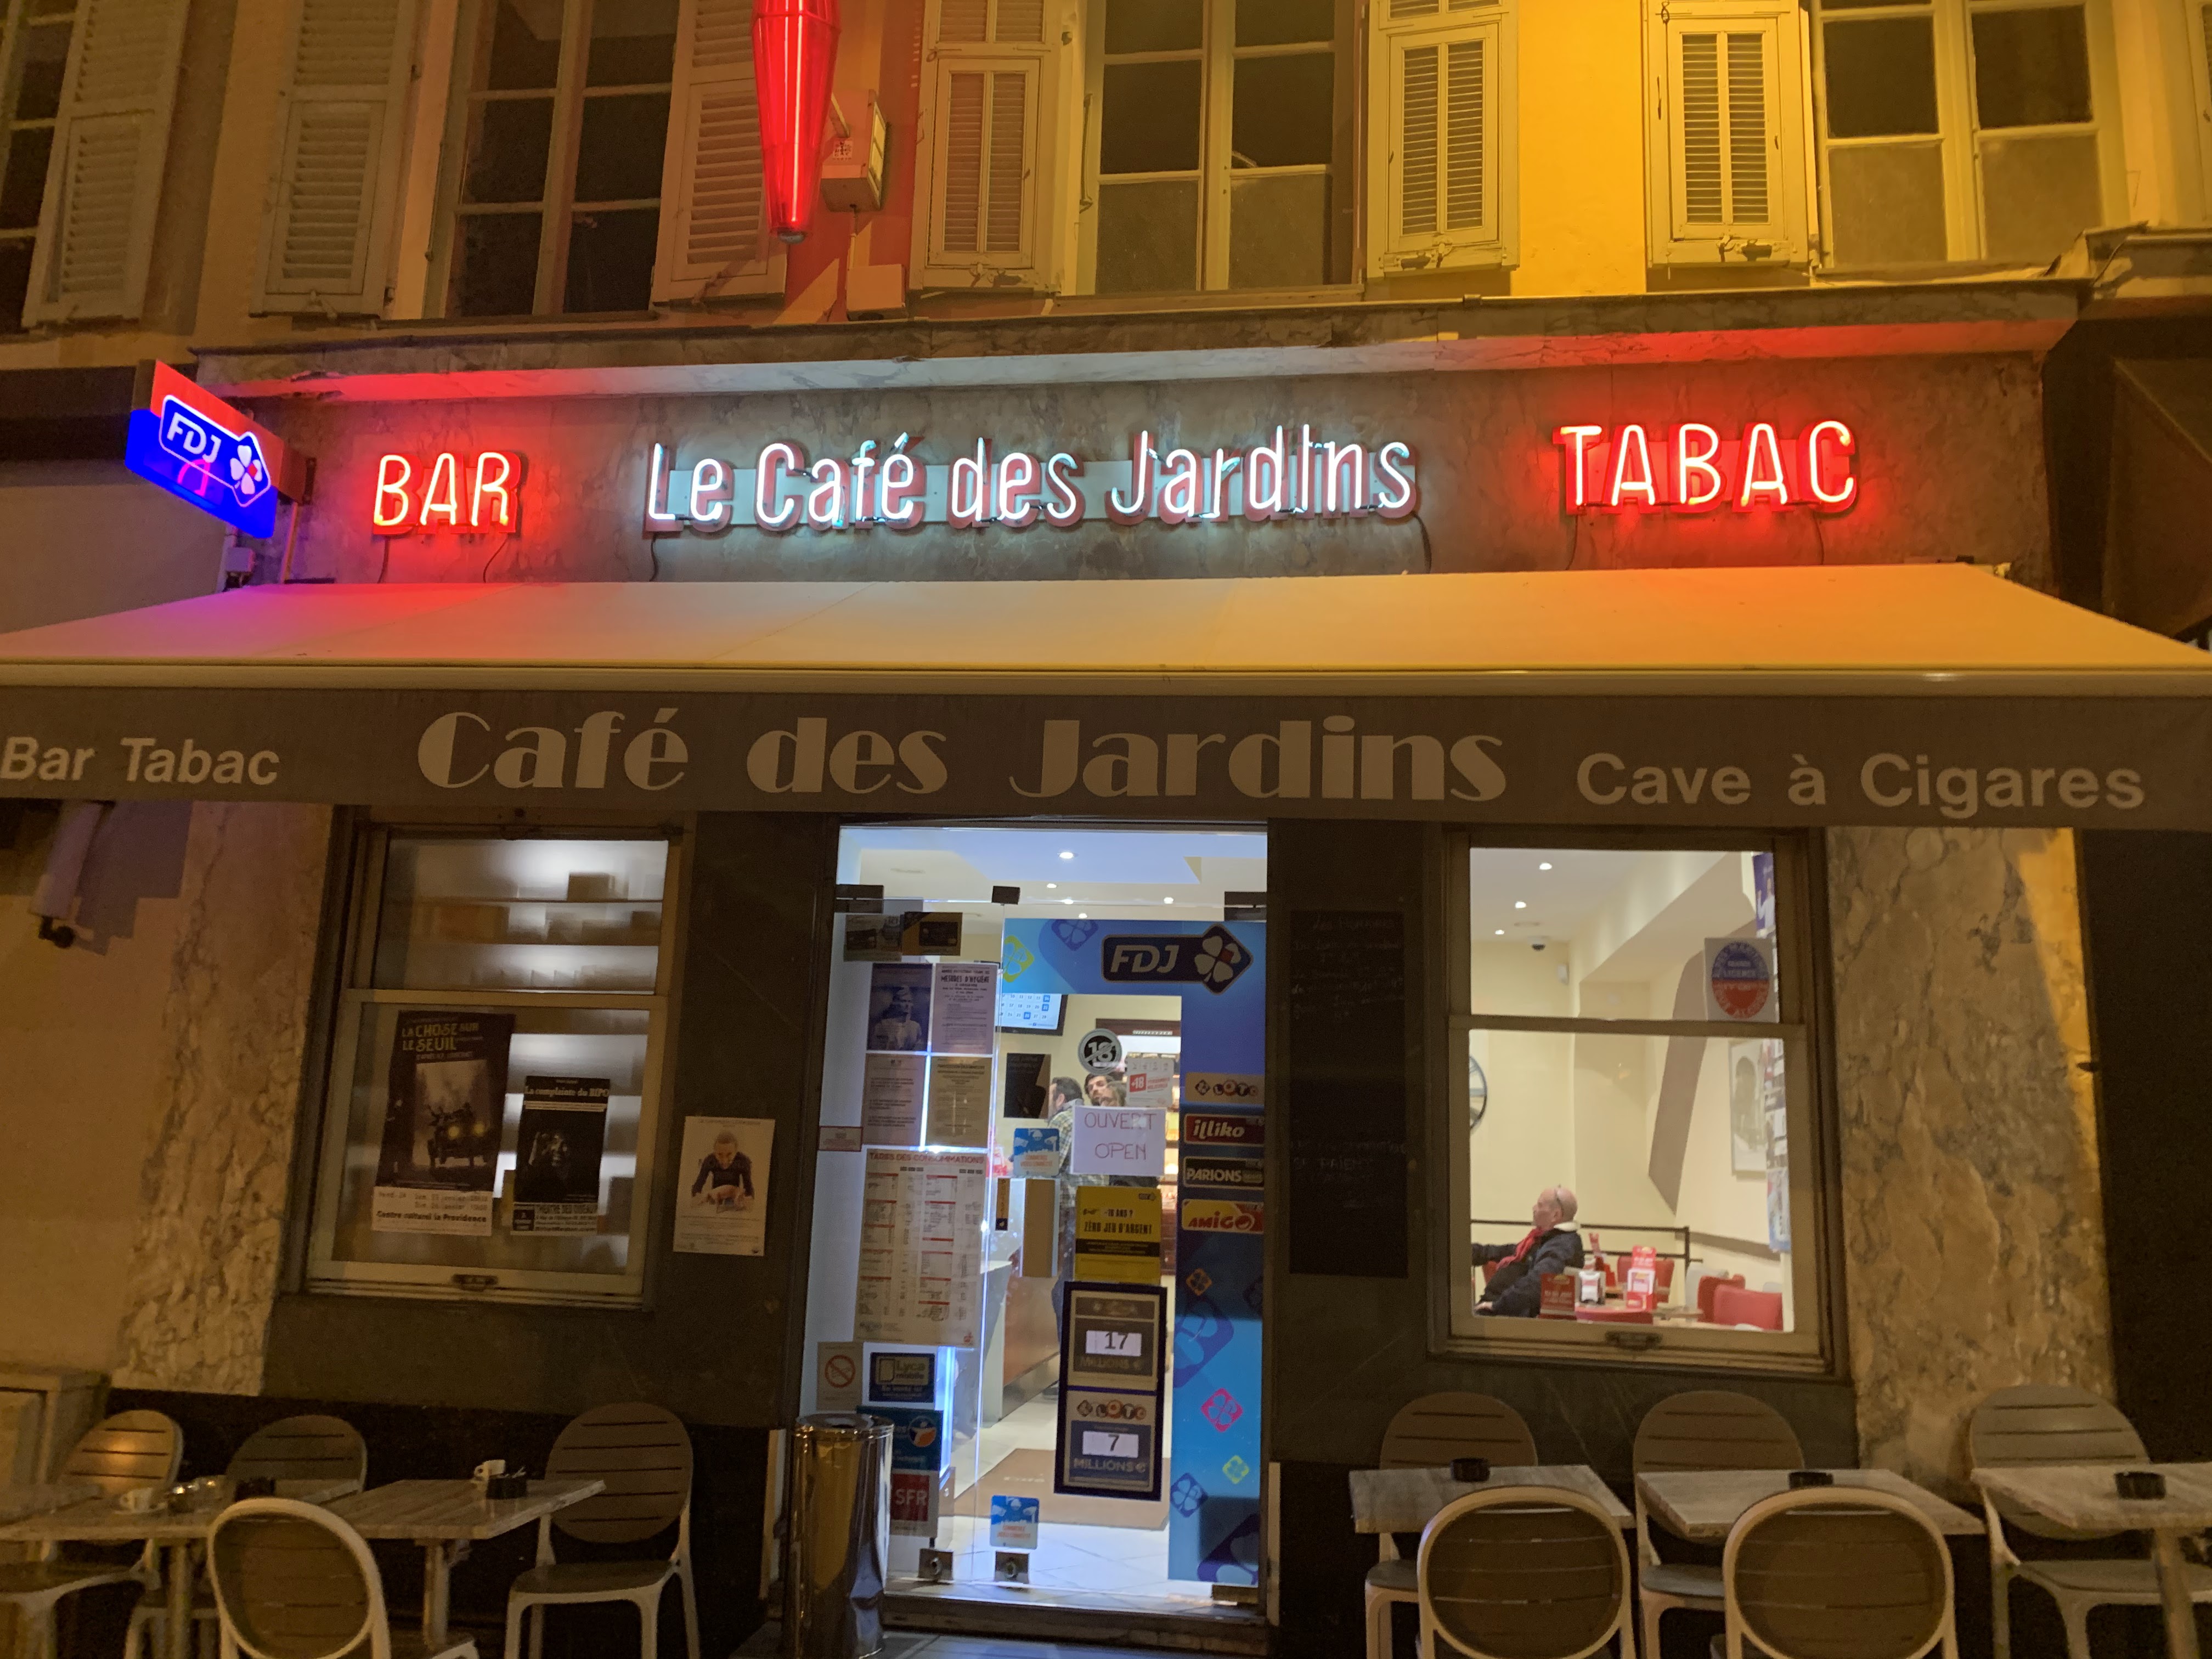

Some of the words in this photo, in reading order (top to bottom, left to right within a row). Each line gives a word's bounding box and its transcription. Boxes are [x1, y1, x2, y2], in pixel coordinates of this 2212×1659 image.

[166, 411, 222, 464] FDJ
[1555, 420, 1857, 513] TABAC
[643, 442, 733, 531] Le
[754, 431, 926, 529] Café
[946, 437, 1084, 528] des
[1104, 422, 1418, 527] Jardins
[373, 452, 519, 534] BAR
[1, 736, 97, 782] Bar
[118, 737, 281, 786] Tabac
[417, 707, 689, 791] Café
[746, 717, 949, 795] des
[1008, 714, 1506, 802] Jardins
[1576, 752, 1752, 806] Cave
[1787, 753, 1827, 806] à
[1860, 752, 2146, 820] Cigares
[1109, 944, 1180, 974] FDJ
[415, 1023, 458, 1037] CHOSE
[402, 1040, 415, 1051] LE
[415, 1037, 457, 1052] SEUIL
[1084, 1111, 1156, 1130] OUVERT
[1193, 1119, 1245, 1139] illiko
[1094, 1142, 1147, 1160] OPEN
[1186, 1167, 1242, 1183] PARIONS
[1104, 1332, 1128, 1350] 17
[1108, 1434, 1120, 1452] 7
[1073, 1458, 1134, 1472] MILLIONS
[895, 1488, 928, 1506] SFR
